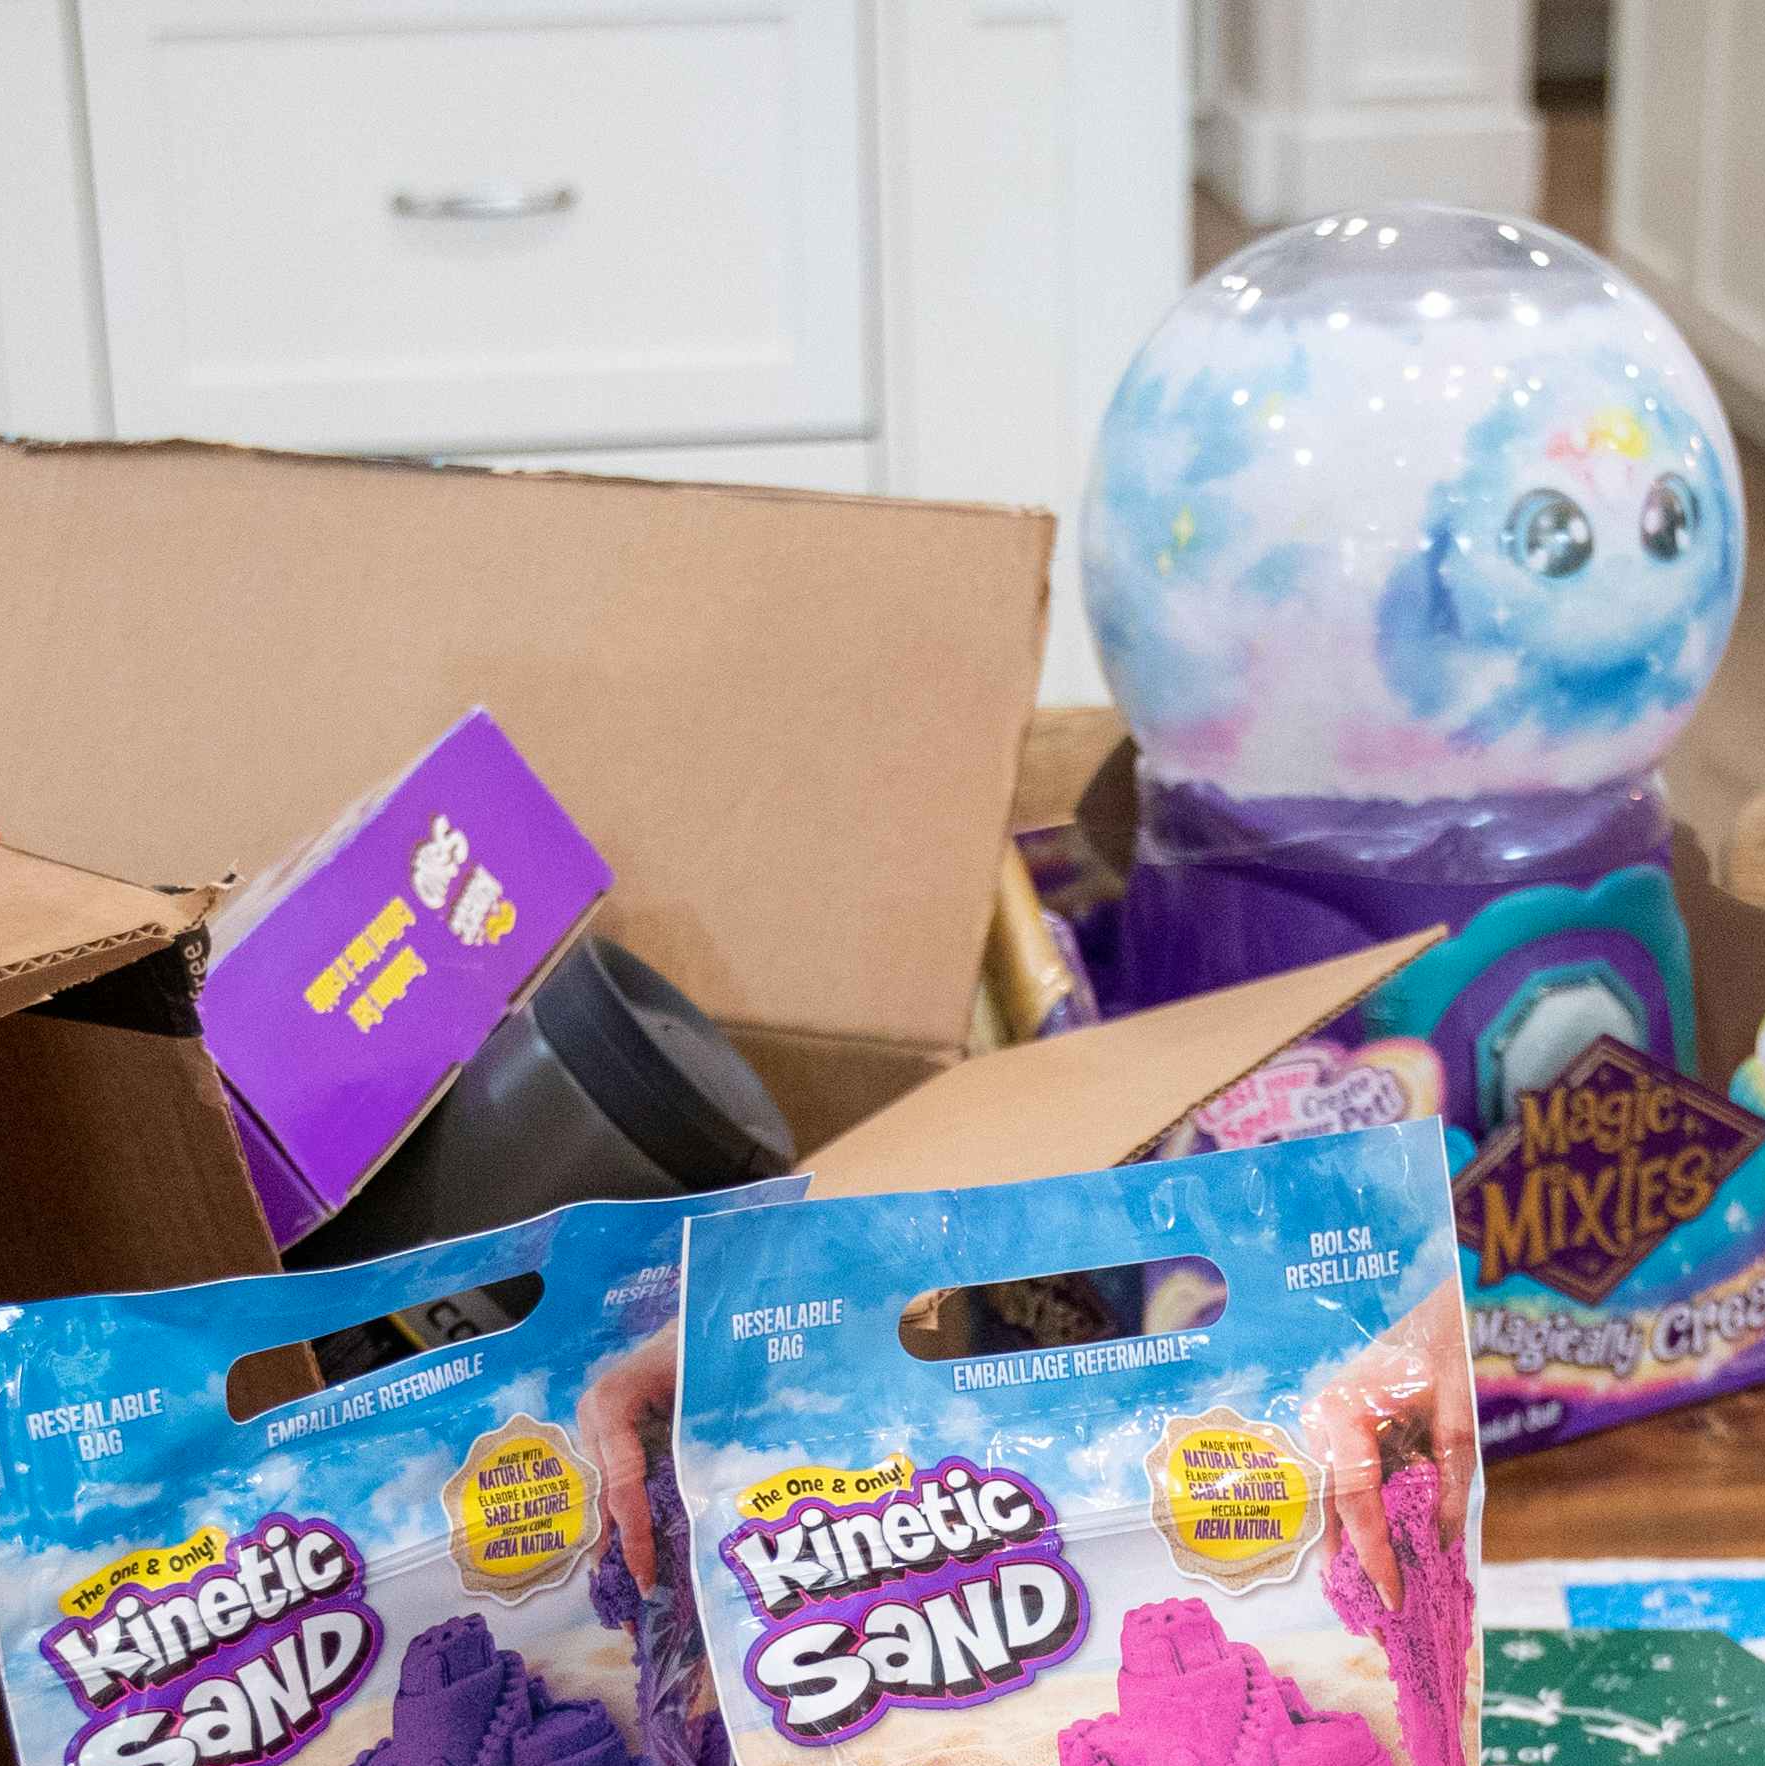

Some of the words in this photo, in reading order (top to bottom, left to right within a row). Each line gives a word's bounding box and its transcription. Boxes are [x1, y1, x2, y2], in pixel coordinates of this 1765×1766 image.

[1520, 1074, 1681, 1161] Magic
[1480, 1142, 1714, 1285] MIXIES
[1309, 1226, 1372, 1257] BOLSA
[1285, 1249, 1399, 1291] RESELLABLE
[732, 1297, 843, 1340] RESEALABLE
[767, 1336, 804, 1362] BAG
[953, 1356, 1067, 1392] EMBALLAGE
[1072, 1338, 1191, 1378] REFERMABLE
[25, 1389, 164, 1442] RESEALABLE
[265, 1394, 373, 1449] EMBALLAGE
[372, 1352, 485, 1416] REFERMABLE
[78, 1430, 123, 1462] BAG
[498, 1452, 519, 1466] MADE
[522, 1448, 543, 1462] WITH
[1183, 1450, 1242, 1469] NATURAL
[1200, 1440, 1224, 1449] MADE
[1228, 1441, 1252, 1451] WITH
[479, 1462, 531, 1491] NATURAL
[533, 1457, 562, 1479] SAND
[530, 1480, 559, 1497] PARTIR
[560, 1479, 570, 1490] DE
[750, 1485, 781, 1513] The
[785, 1475, 824, 1495] One
[832, 1476, 848, 1493] &
[855, 1462, 905, 1493] Only!
[1274, 1472, 1287, 1480] DE
[1234, 1482, 1289, 1500] NATUREL
[484, 1502, 520, 1527] SABLE
[524, 1492, 570, 1520] NATUREL
[1212, 1505, 1241, 1517] HECHA
[1244, 1505, 1270, 1517] COMO
[484, 1537, 518, 1560] ARENA
[522, 1532, 565, 1556] NATURAL
[732, 1469, 1031, 1608] Kinetic
[1195, 1520, 1231, 1540] ARENA
[1234, 1520, 1283, 1540] NATURAL
[70, 1582, 108, 1612] The
[110, 1559, 142, 1584] One
[145, 1559, 160, 1577] &
[164, 1532, 220, 1572] Only!
[48, 1525, 346, 1703] Kinetic
[1518, 1743, 1558, 1763] of
